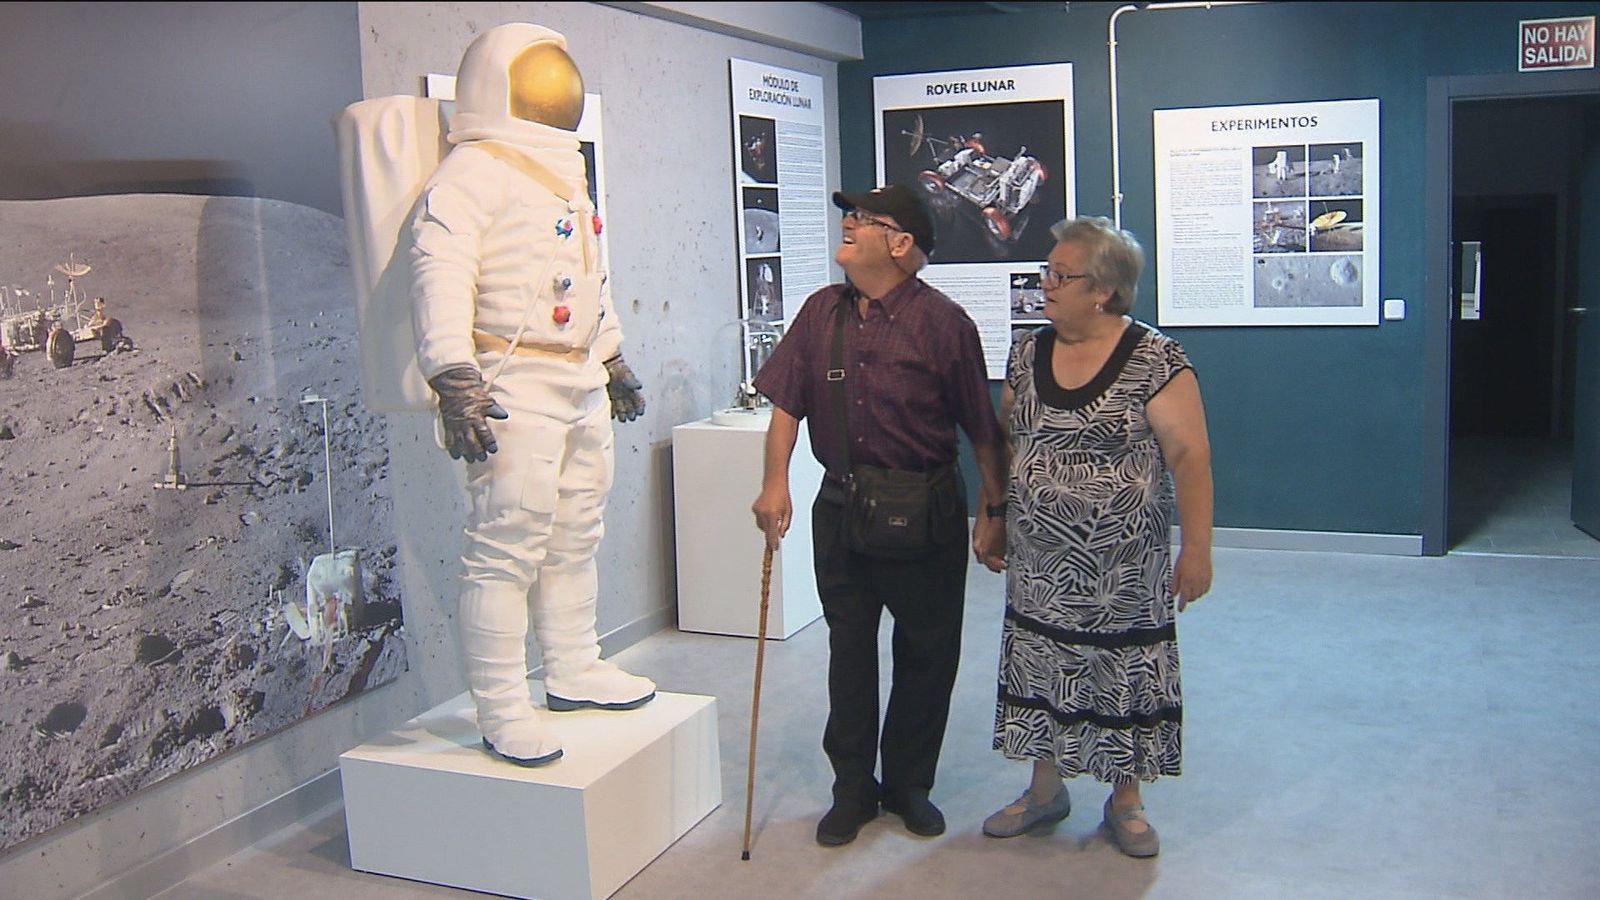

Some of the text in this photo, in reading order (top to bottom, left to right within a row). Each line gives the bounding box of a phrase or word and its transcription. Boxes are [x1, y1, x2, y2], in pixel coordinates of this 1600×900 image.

[1524, 25, 1587, 44] NO HAY
[1525, 45, 1588, 64] SALIDA
[763, 74, 799, 92] MÓDULO DE
[926, 80, 1014, 95] ROVER LUNAR
[749, 88, 811, 109] EXPLORACIÓN LUNAR
[1211, 115, 1318, 132] EXPERIMENTOS
